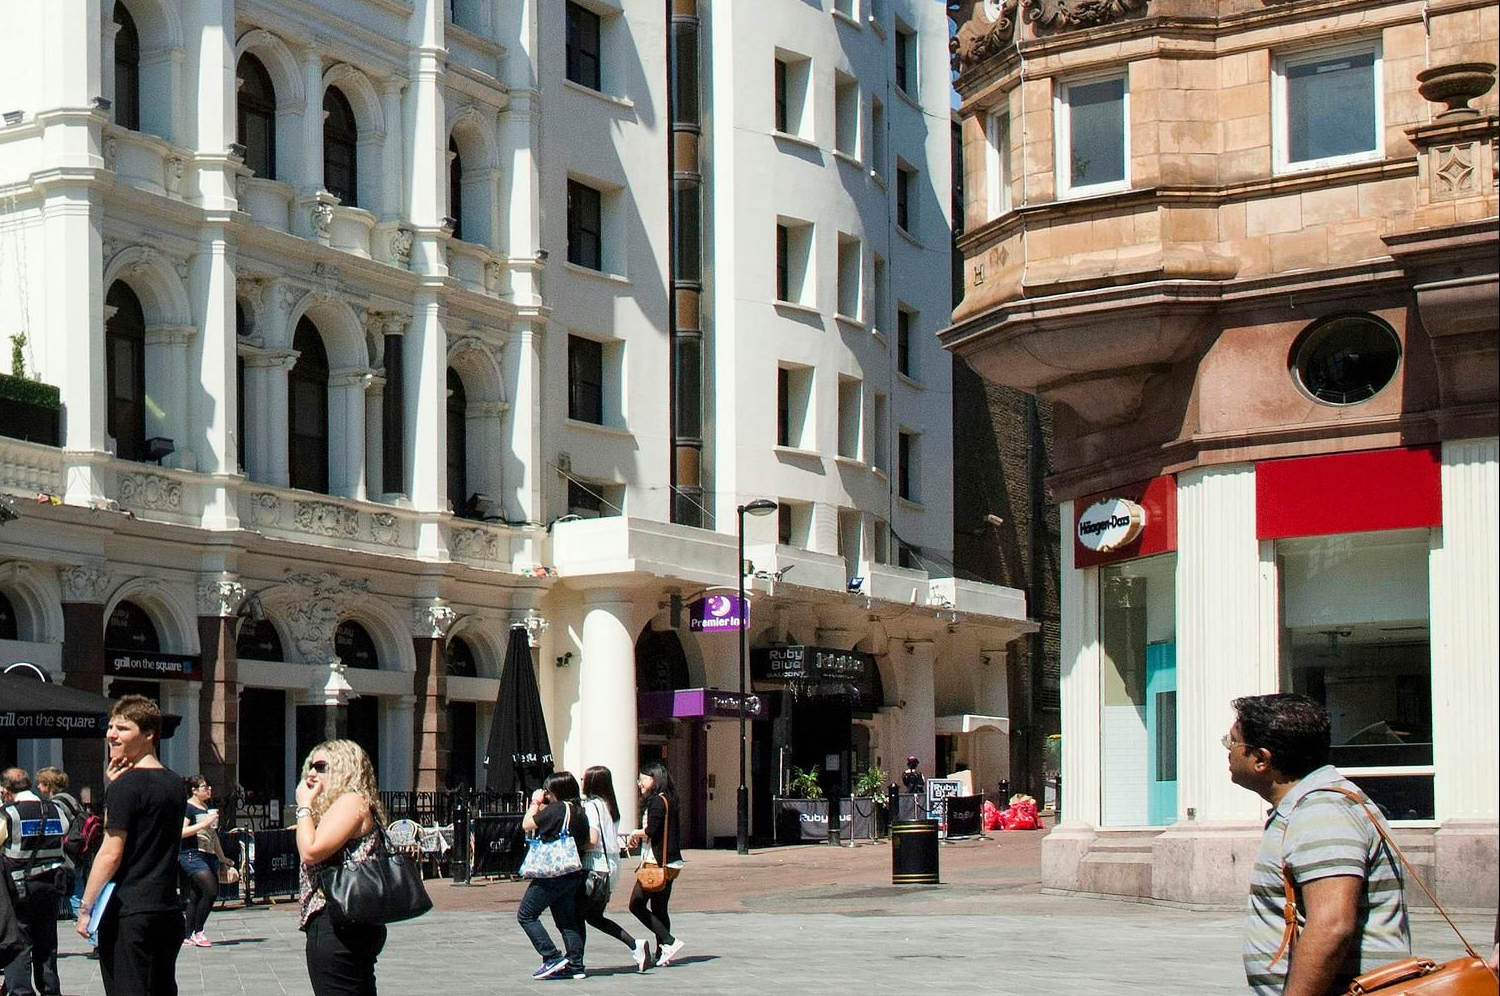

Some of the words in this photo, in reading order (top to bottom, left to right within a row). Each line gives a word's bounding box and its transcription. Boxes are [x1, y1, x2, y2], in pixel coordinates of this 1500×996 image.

[691, 618, 729, 628] Premier
[769, 649, 804, 661] Ruby
[114, 656, 131, 670] grill
[131, 660, 142, 669] on
[142, 658, 155, 669] the
[155, 660, 182, 672] square
[771, 660, 802, 670] Blue
[16, 715, 33, 726] on
[35, 713, 54, 727] the
[56, 716, 96, 731] square
[934, 783, 958, 792] Ruby
